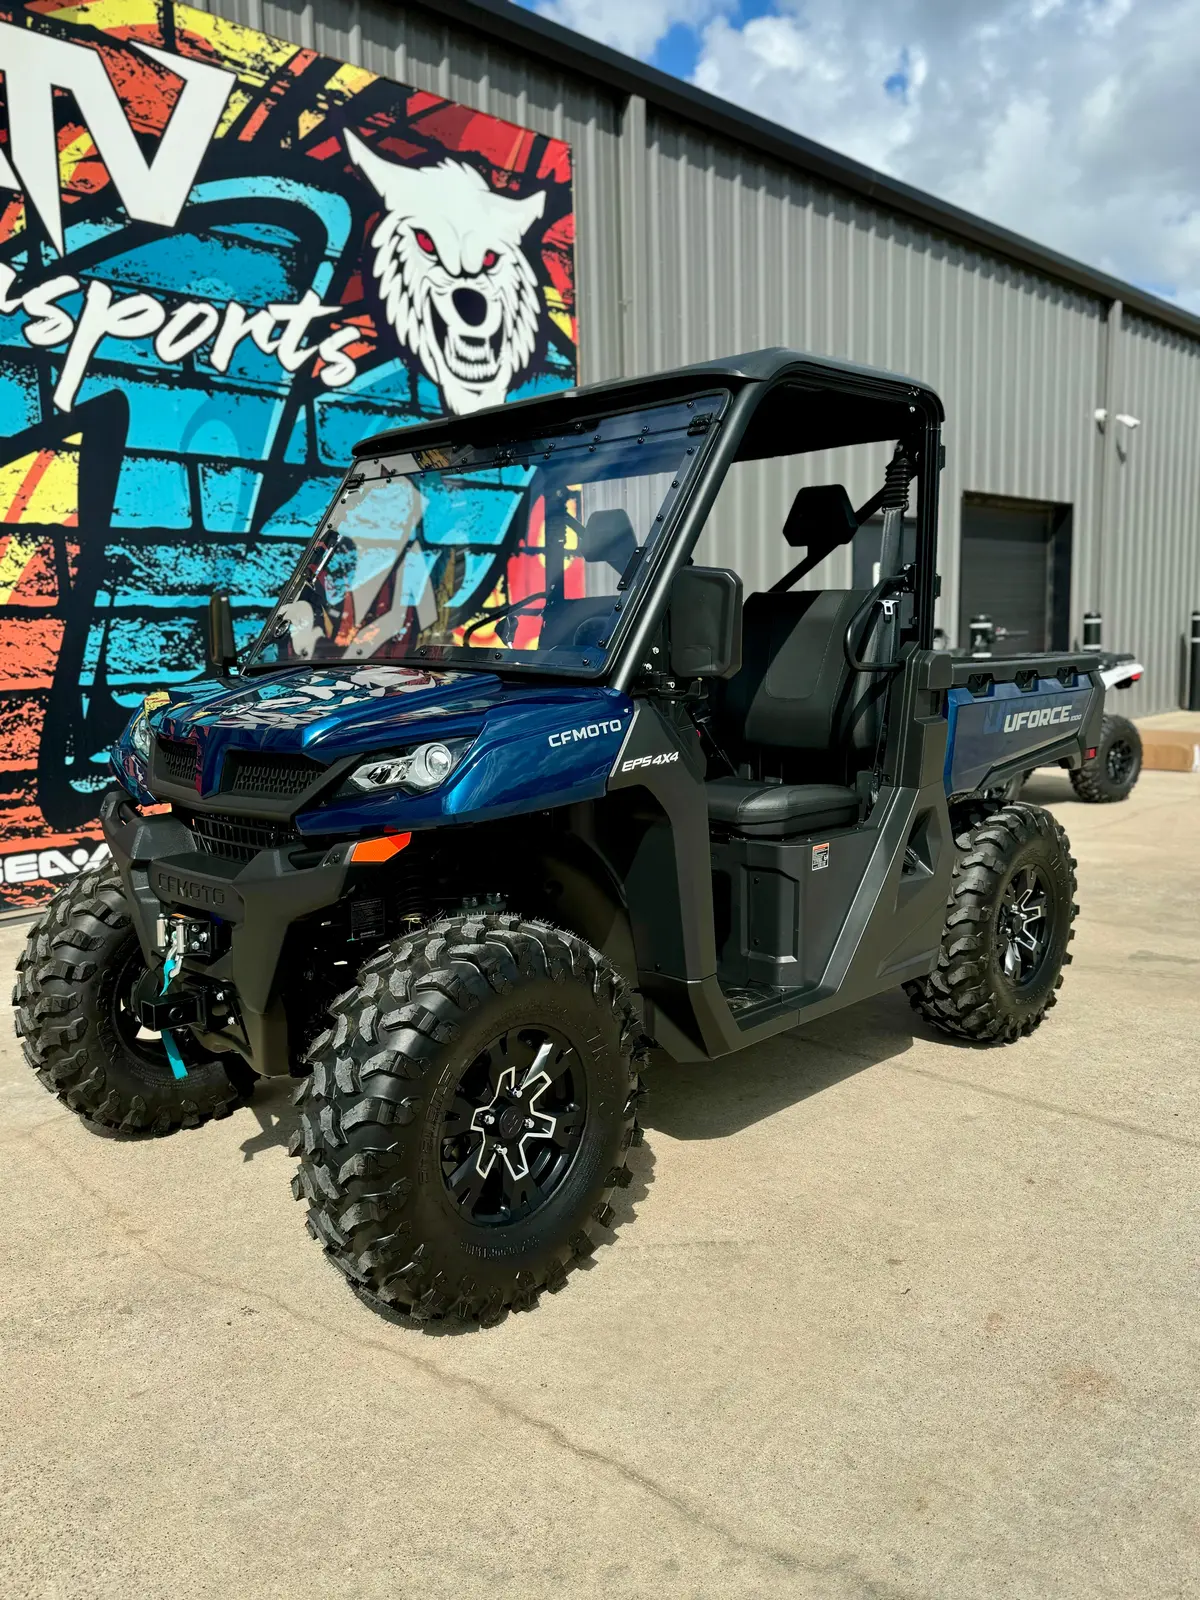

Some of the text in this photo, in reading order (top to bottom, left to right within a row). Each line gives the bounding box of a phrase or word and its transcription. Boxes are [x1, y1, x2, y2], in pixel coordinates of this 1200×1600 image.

[0, 21, 237, 258] TV
[548, 719, 622, 748] CFMOTO
[1003, 705, 1073, 733] UFORCE
[158, 872, 225, 907] CFMOTO
